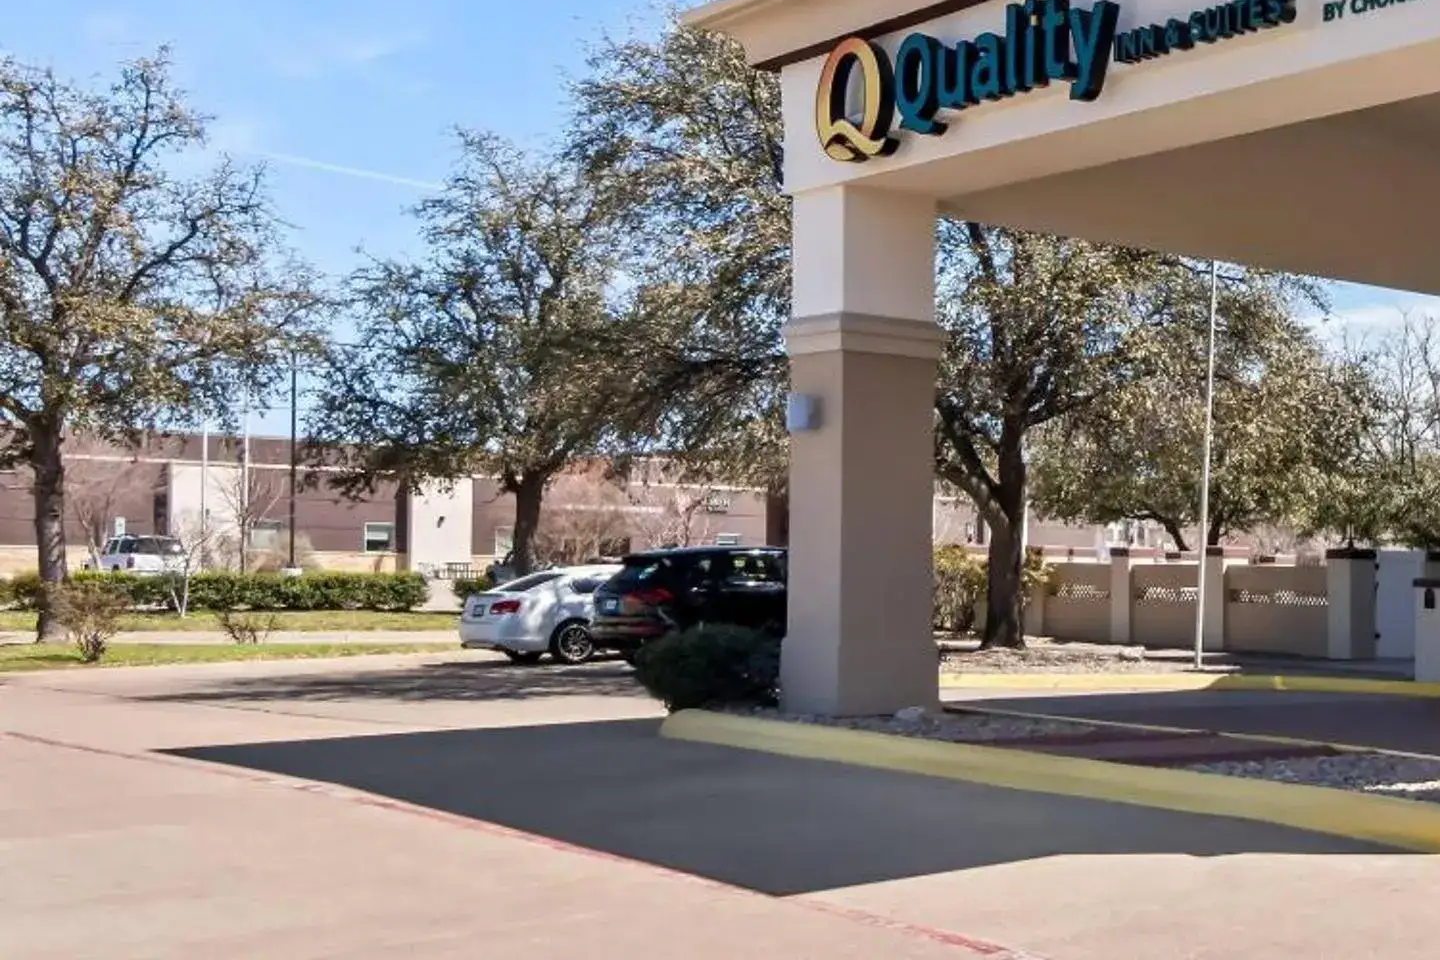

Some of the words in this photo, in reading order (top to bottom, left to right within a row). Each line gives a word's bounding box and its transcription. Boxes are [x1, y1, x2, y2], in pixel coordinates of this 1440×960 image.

[1322, 0, 1347, 22] BY
[1113, 24, 1169, 64] INN
[1164, 18, 1195, 51] &
